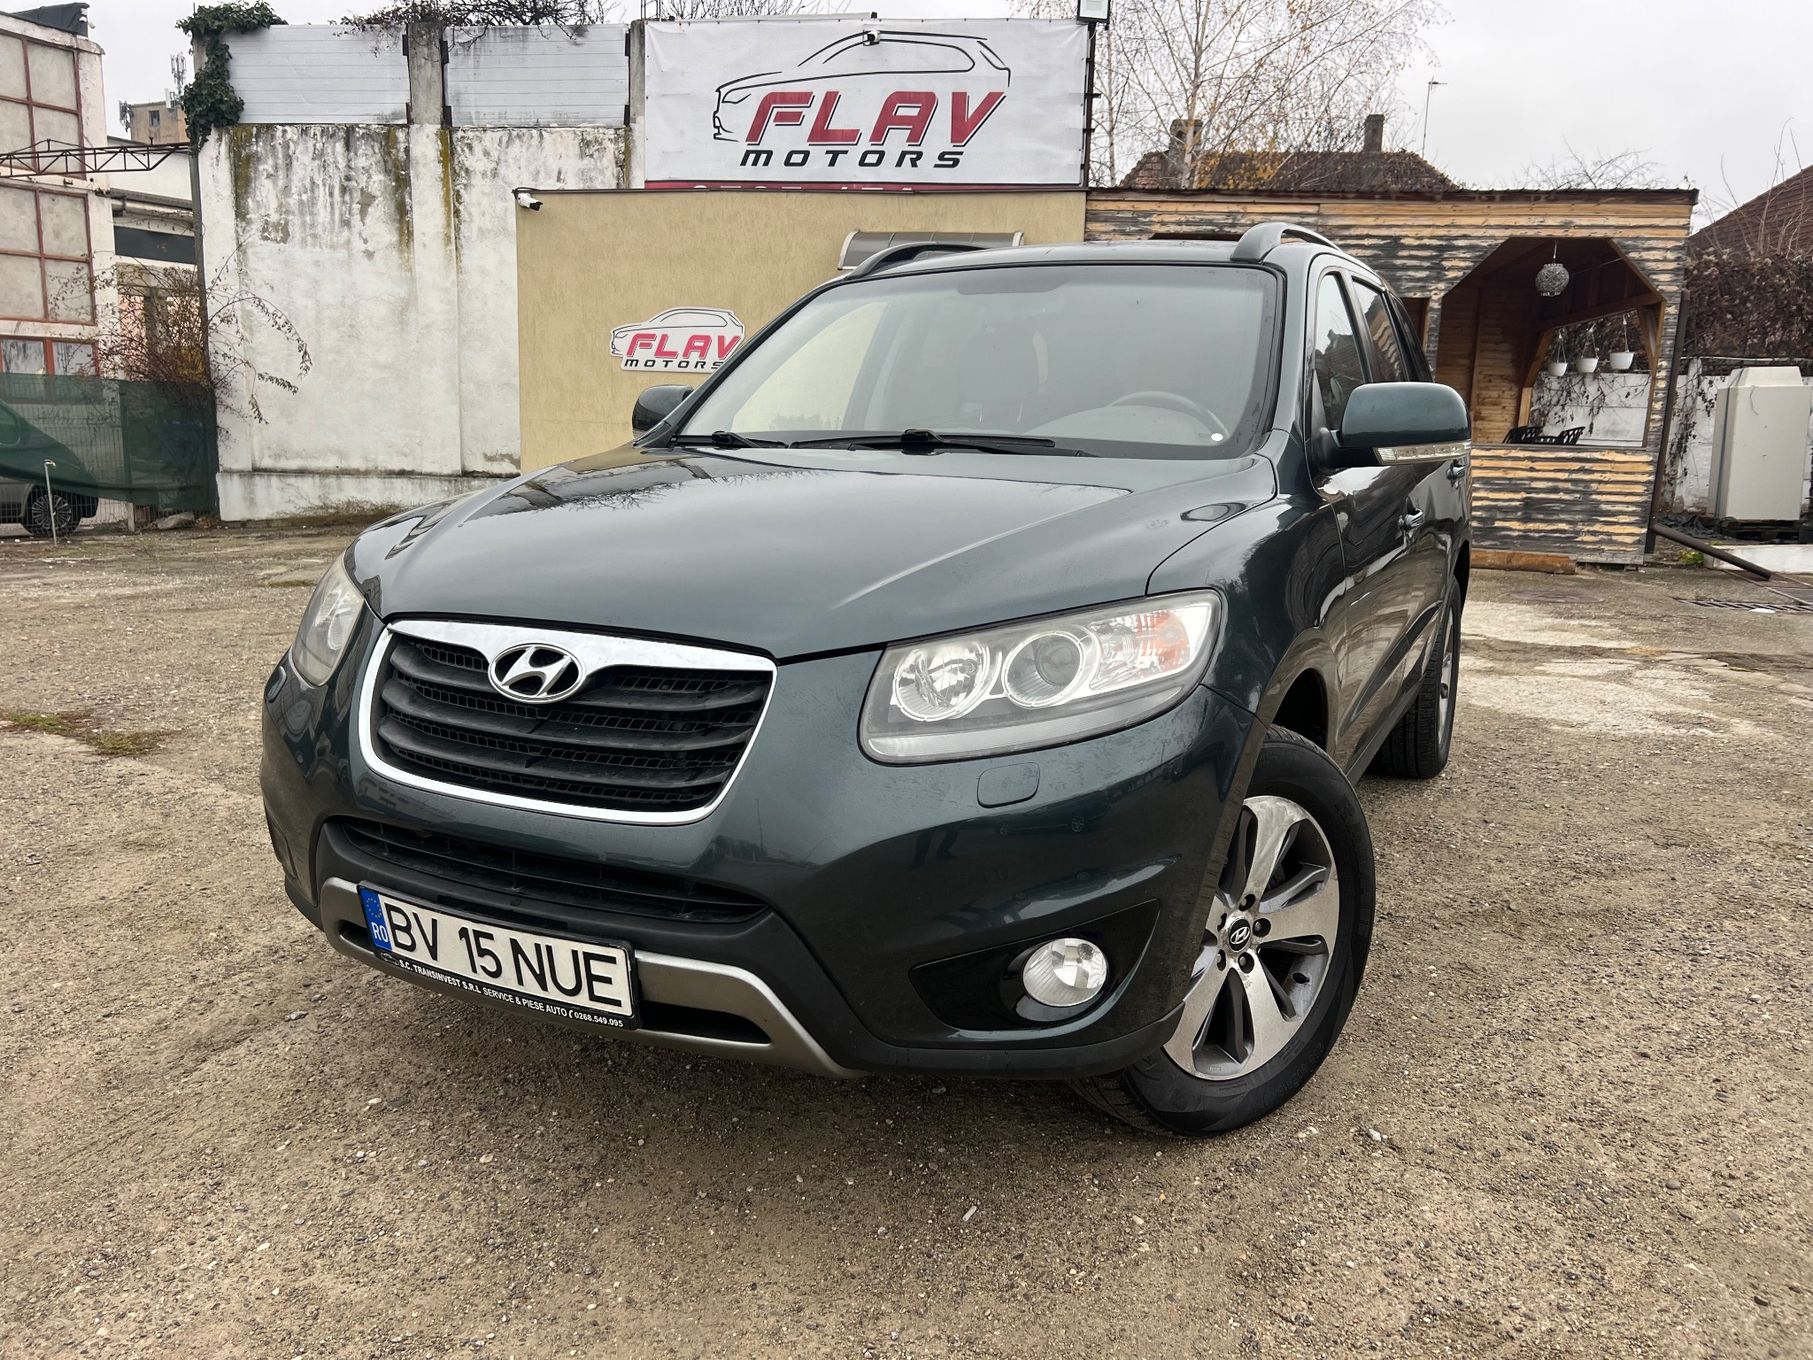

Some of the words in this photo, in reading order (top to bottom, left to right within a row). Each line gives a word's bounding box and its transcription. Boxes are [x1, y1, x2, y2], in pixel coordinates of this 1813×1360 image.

[745, 91, 1006, 147] FLAV
[740, 150, 964, 168] MOTORS
[626, 333, 742, 360] FLAV
[624, 359, 724, 369] MOTORS
[373, 922, 389, 943] RO
[385, 903, 438, 961] BV
[458, 927, 503, 978] 15
[510, 938, 622, 1007] NUE
[413, 964, 461, 987] TRANSINVEST
[483, 987, 514, 1003] SERVICE
[515, 996, 521, 1005] &
[522, 998, 545, 1012] PIESE
[546, 1004, 567, 1017] AUTO
[574, 1012, 624, 1028] 0268.549.095
